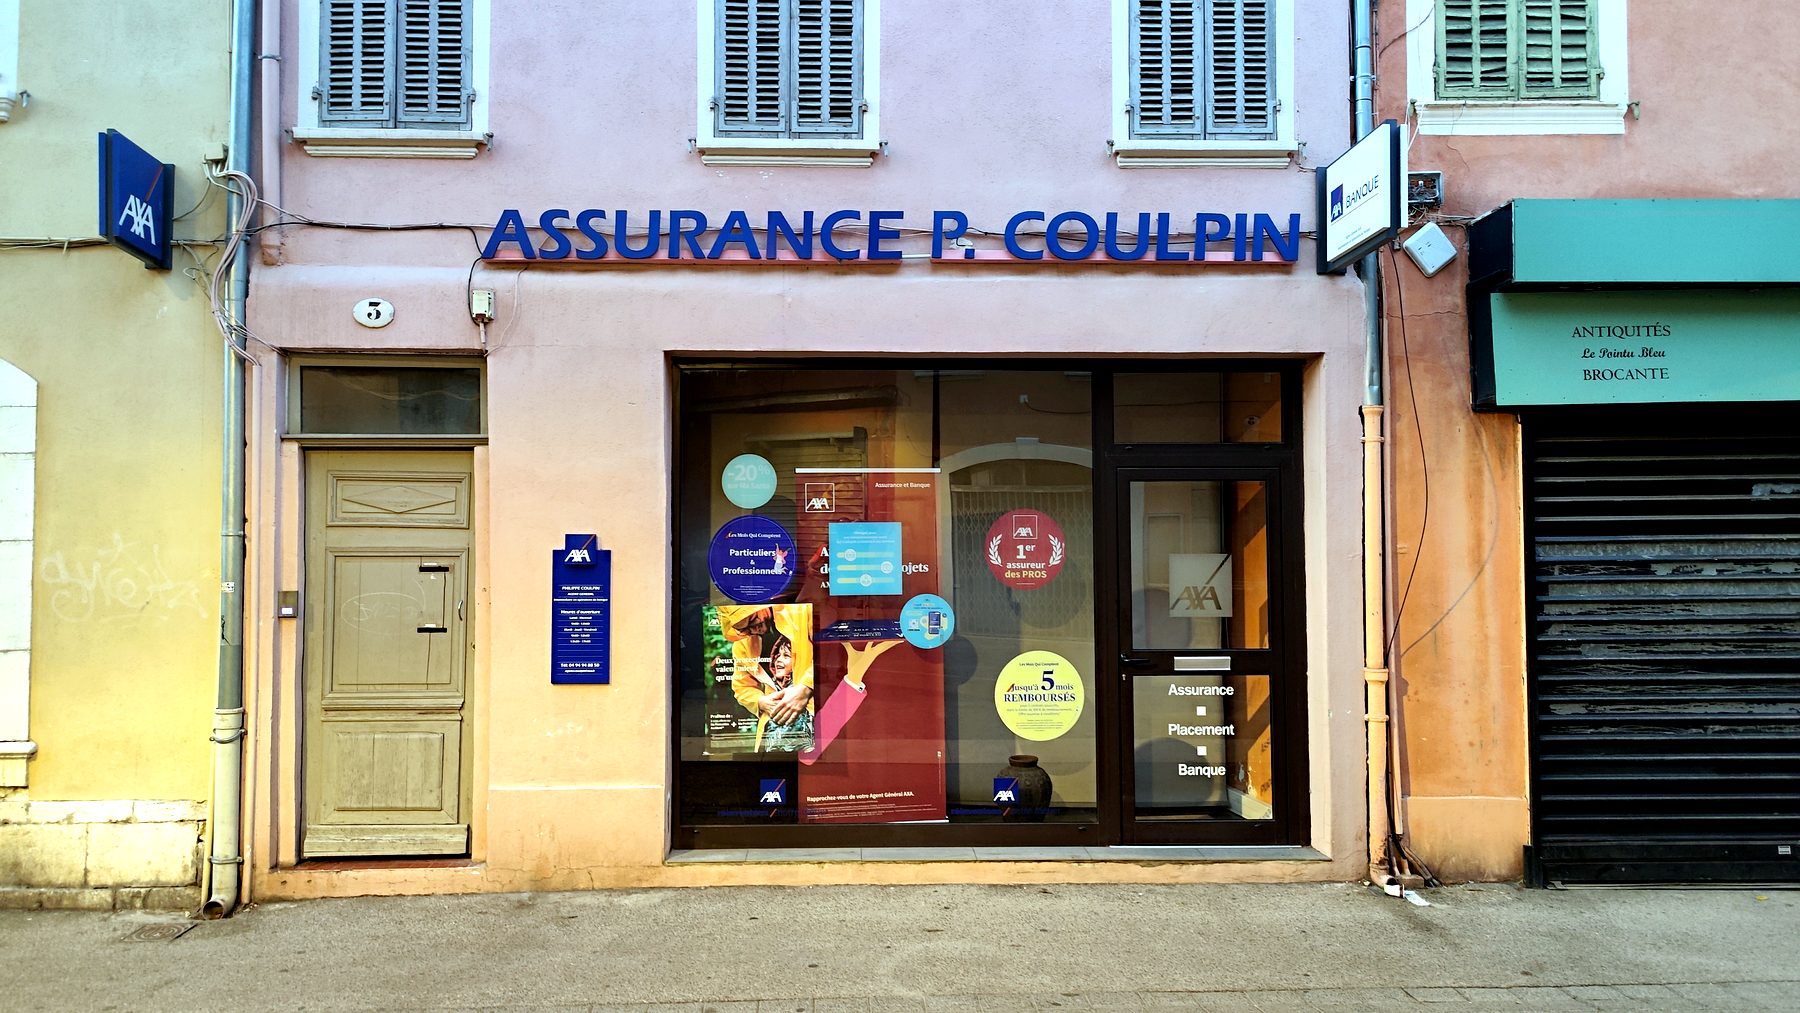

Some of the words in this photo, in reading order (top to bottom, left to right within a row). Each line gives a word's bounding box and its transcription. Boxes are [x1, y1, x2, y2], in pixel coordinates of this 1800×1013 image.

[1346, 174, 1378, 208] BANQUE
[118, 194, 156, 246] AXA
[482, 209, 904, 260] ASSURANCE
[932, 210, 975, 260] P.
[1004, 210, 1300, 262] COULPIN
[367, 302, 382, 320] 3
[1572, 322, 1671, 339] ANTIQUITÉS
[1581, 348, 1596, 358] Le
[1598, 348, 1635, 358] Pointu
[1638, 346, 1666, 358] Bleu
[1583, 368, 1670, 381] BROCANTE
[806, 497, 830, 510] AXA
[1014, 527, 1033, 536] AXA
[564, 549, 591, 562] AXA
[730, 548, 776, 557] Particuliers
[1016, 544, 1036, 559] 1er
[723, 567, 782, 575] Professionnels
[1004, 570, 1020, 578] des
[1170, 586, 1222, 610] AXA
[1010, 684, 1039, 692] Jusqu'à
[1041, 669, 1055, 691] 5
[1168, 684, 1234, 696] Assurance
[1004, 692, 1076, 702] REMBOURSÉS
[1168, 723, 1235, 736] Placement
[1178, 763, 1226, 778] Banque
[760, 792, 782, 802] AXA
[993, 790, 1016, 801] AXA
